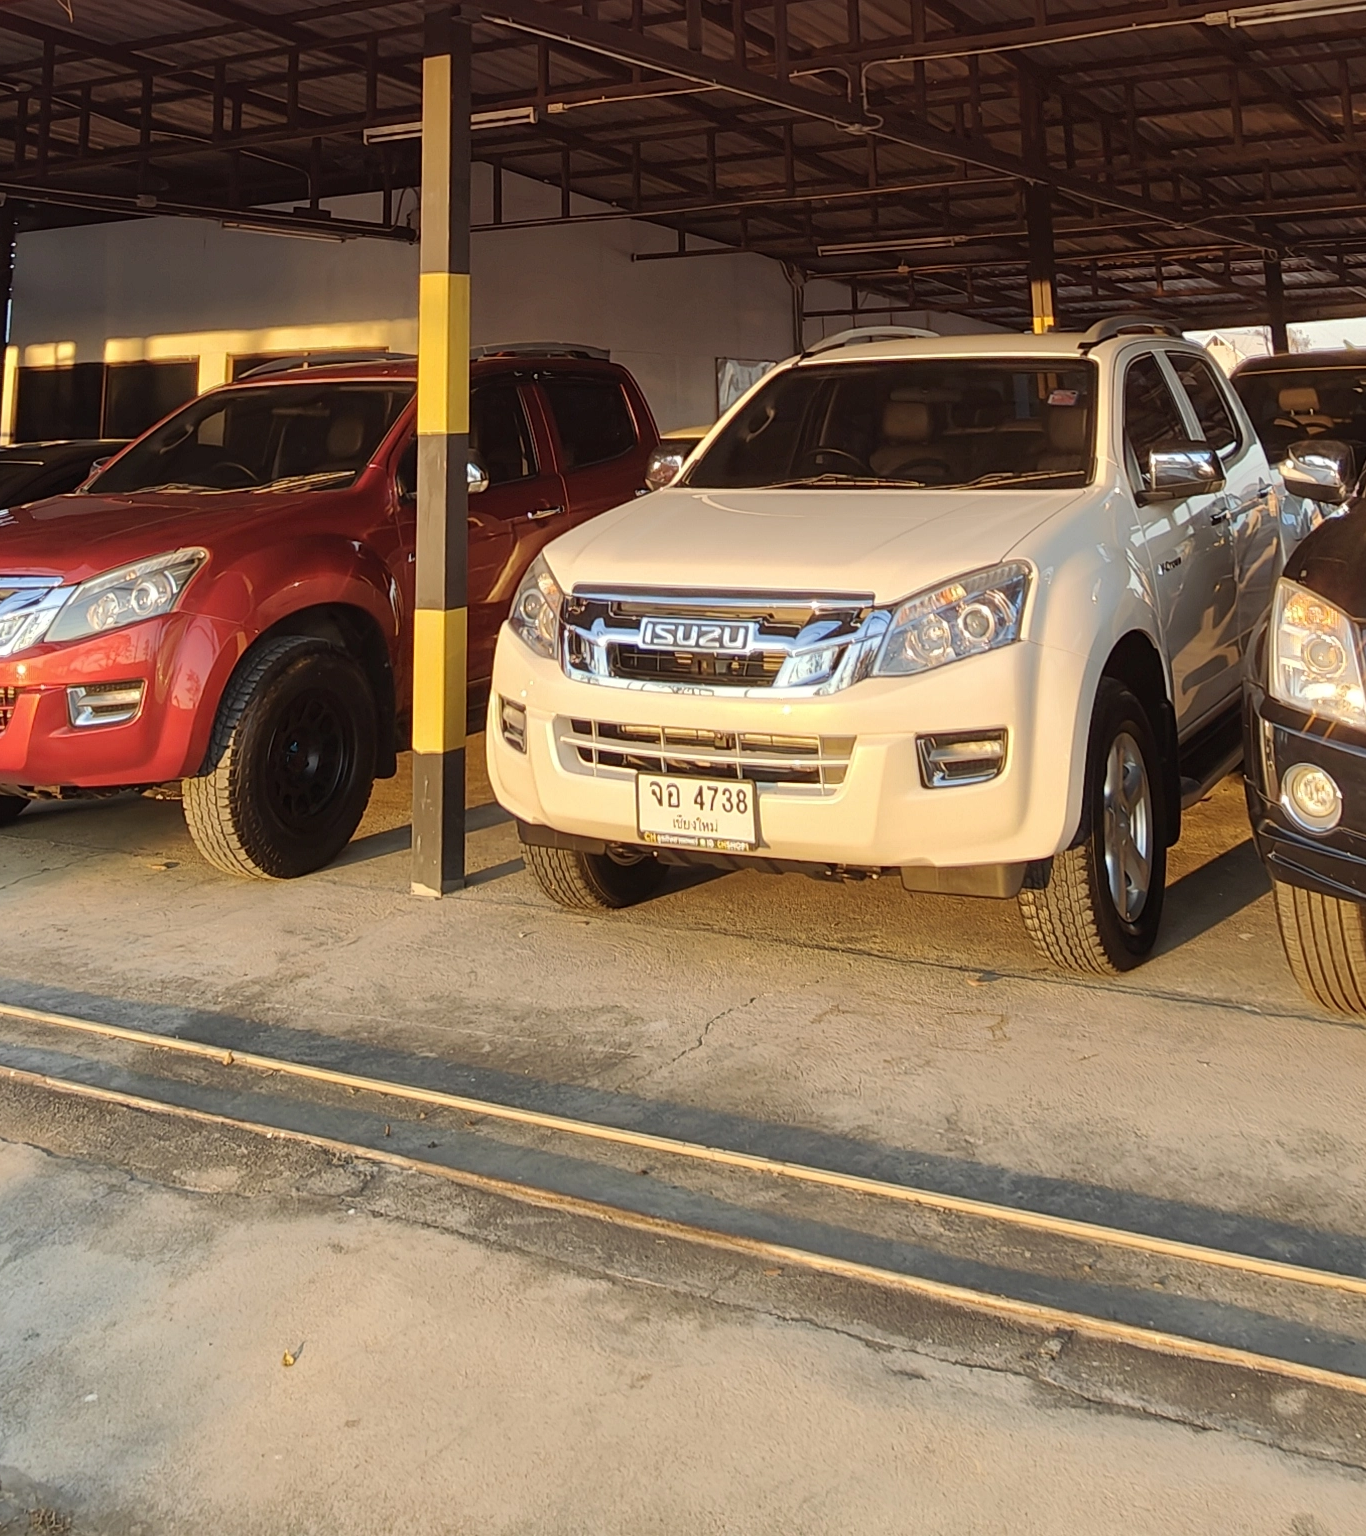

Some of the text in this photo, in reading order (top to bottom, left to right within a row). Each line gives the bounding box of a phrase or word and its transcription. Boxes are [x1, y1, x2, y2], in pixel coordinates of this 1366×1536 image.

[644, 622, 747, 649] ISUZU
[649, 780, 748, 815] จอ 4738
[672, 814, 718, 833] เชียงใหม่
